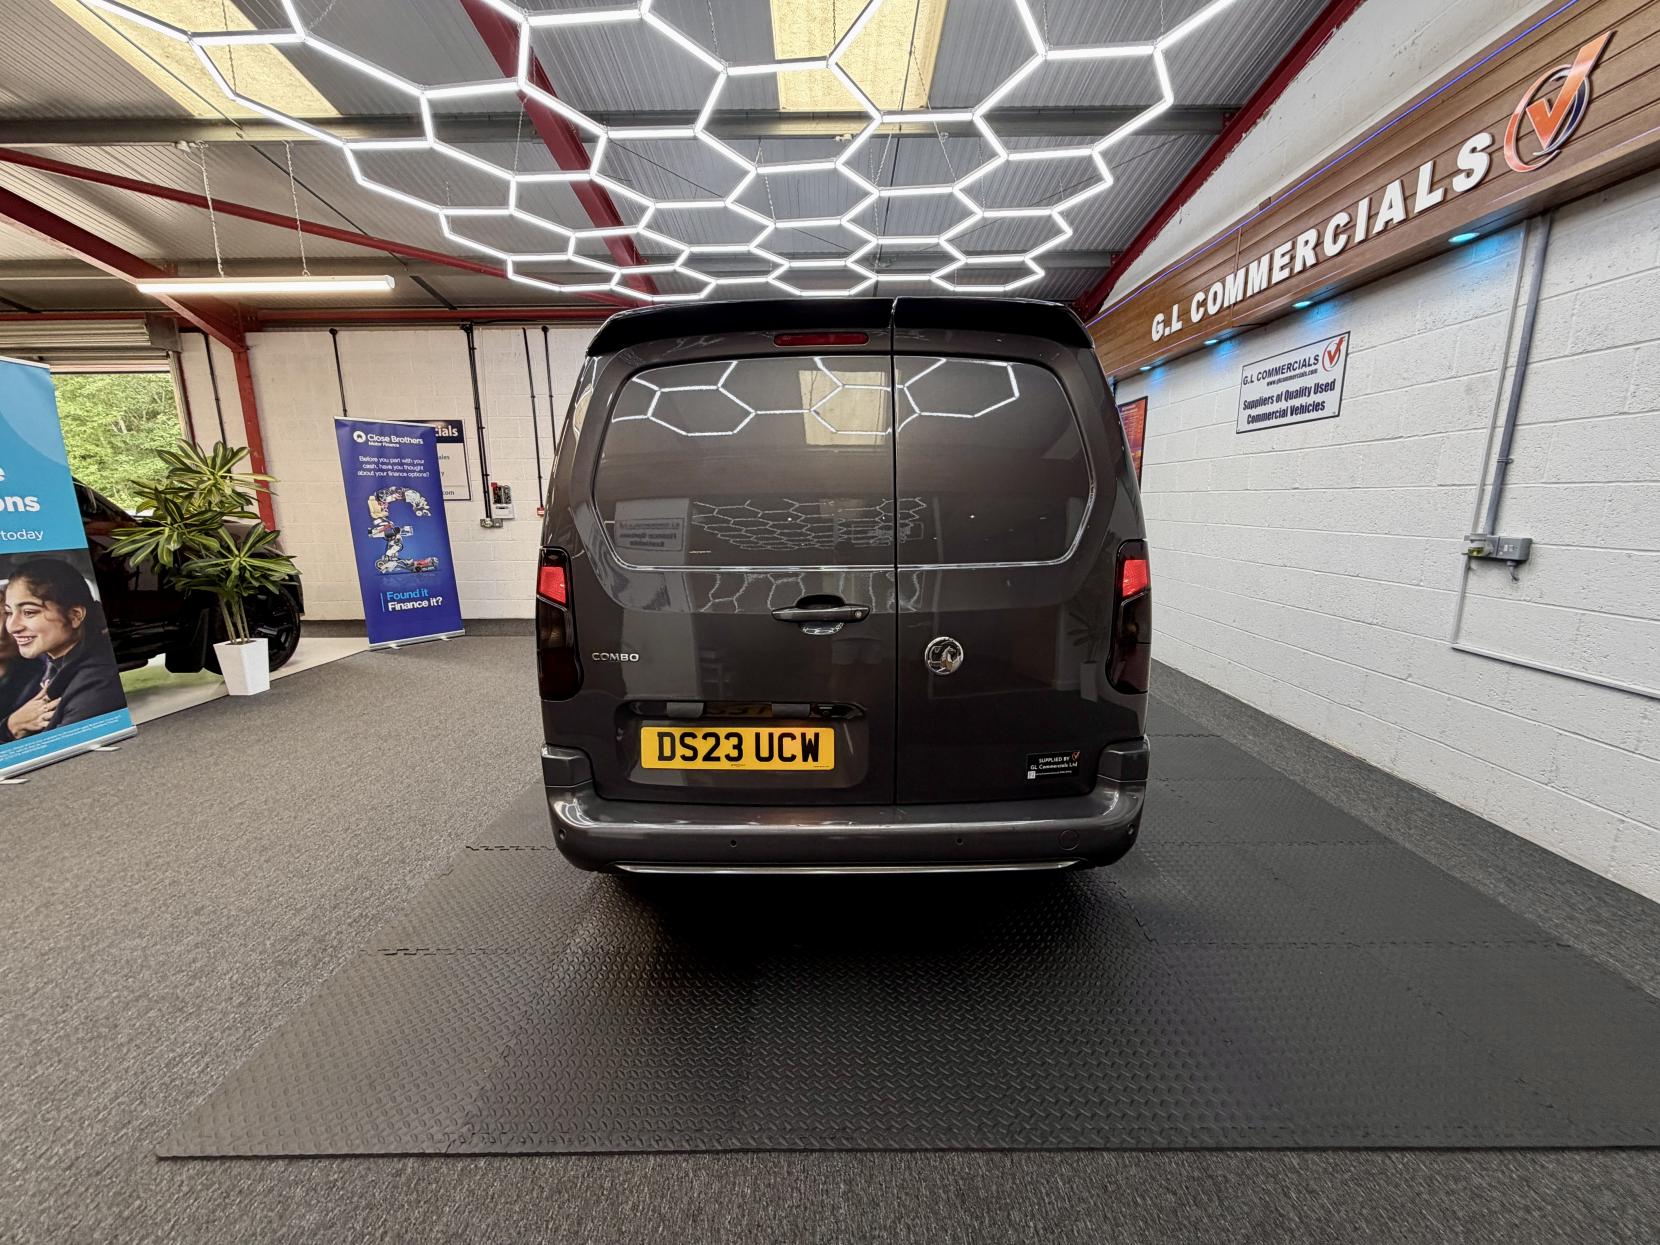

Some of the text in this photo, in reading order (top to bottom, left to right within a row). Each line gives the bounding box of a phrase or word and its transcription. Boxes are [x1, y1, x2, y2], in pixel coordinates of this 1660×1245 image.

[1151, 132, 1492, 342] G.L COMMERCIALS
[1243, 354, 1320, 386] G.L COMMERCIALS
[1243, 378, 1336, 411] Suppliers of Quality Used
[1247, 400, 1326, 424] Commercial Vehicles
[367, 434, 424, 444] Close Brothers
[0, 496, 40, 512] ns
[0, 528, 44, 541] today
[386, 588, 429, 600] Found it
[388, 596, 443, 612] Finance it?
[592, 652, 640, 662] COMBO
[656, 732, 820, 762] DS23 UCW
